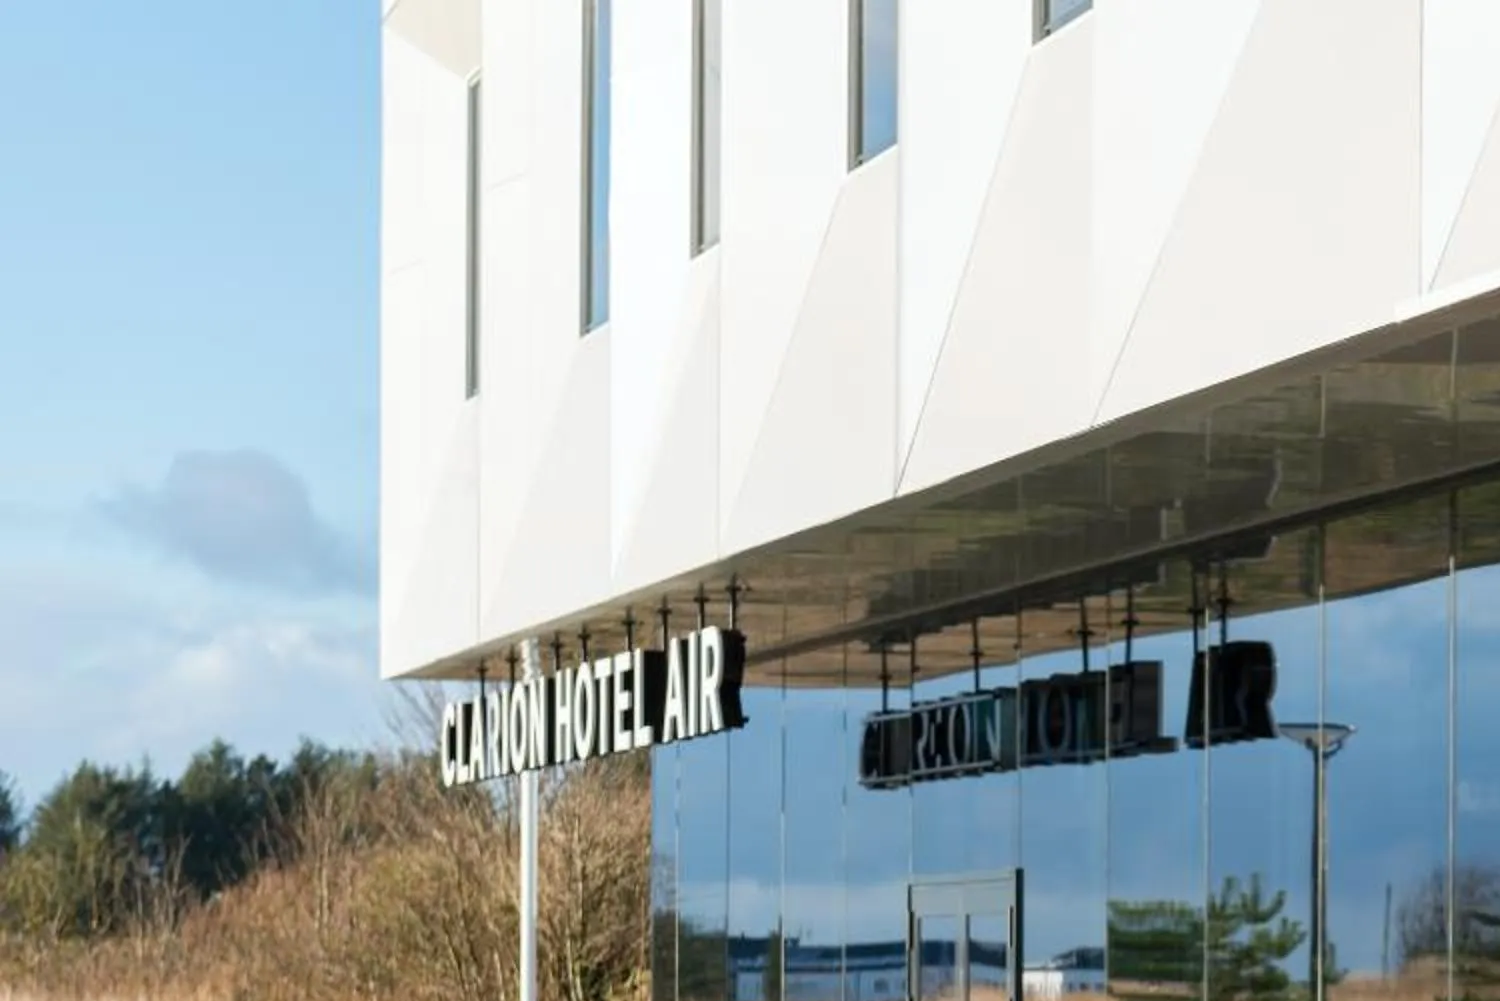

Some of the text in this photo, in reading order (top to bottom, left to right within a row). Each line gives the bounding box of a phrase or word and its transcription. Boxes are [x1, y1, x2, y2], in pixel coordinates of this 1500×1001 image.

[441, 675, 547, 787] CLARION
[555, 648, 653, 764] HOTEL
[662, 626, 724, 743] AIR
